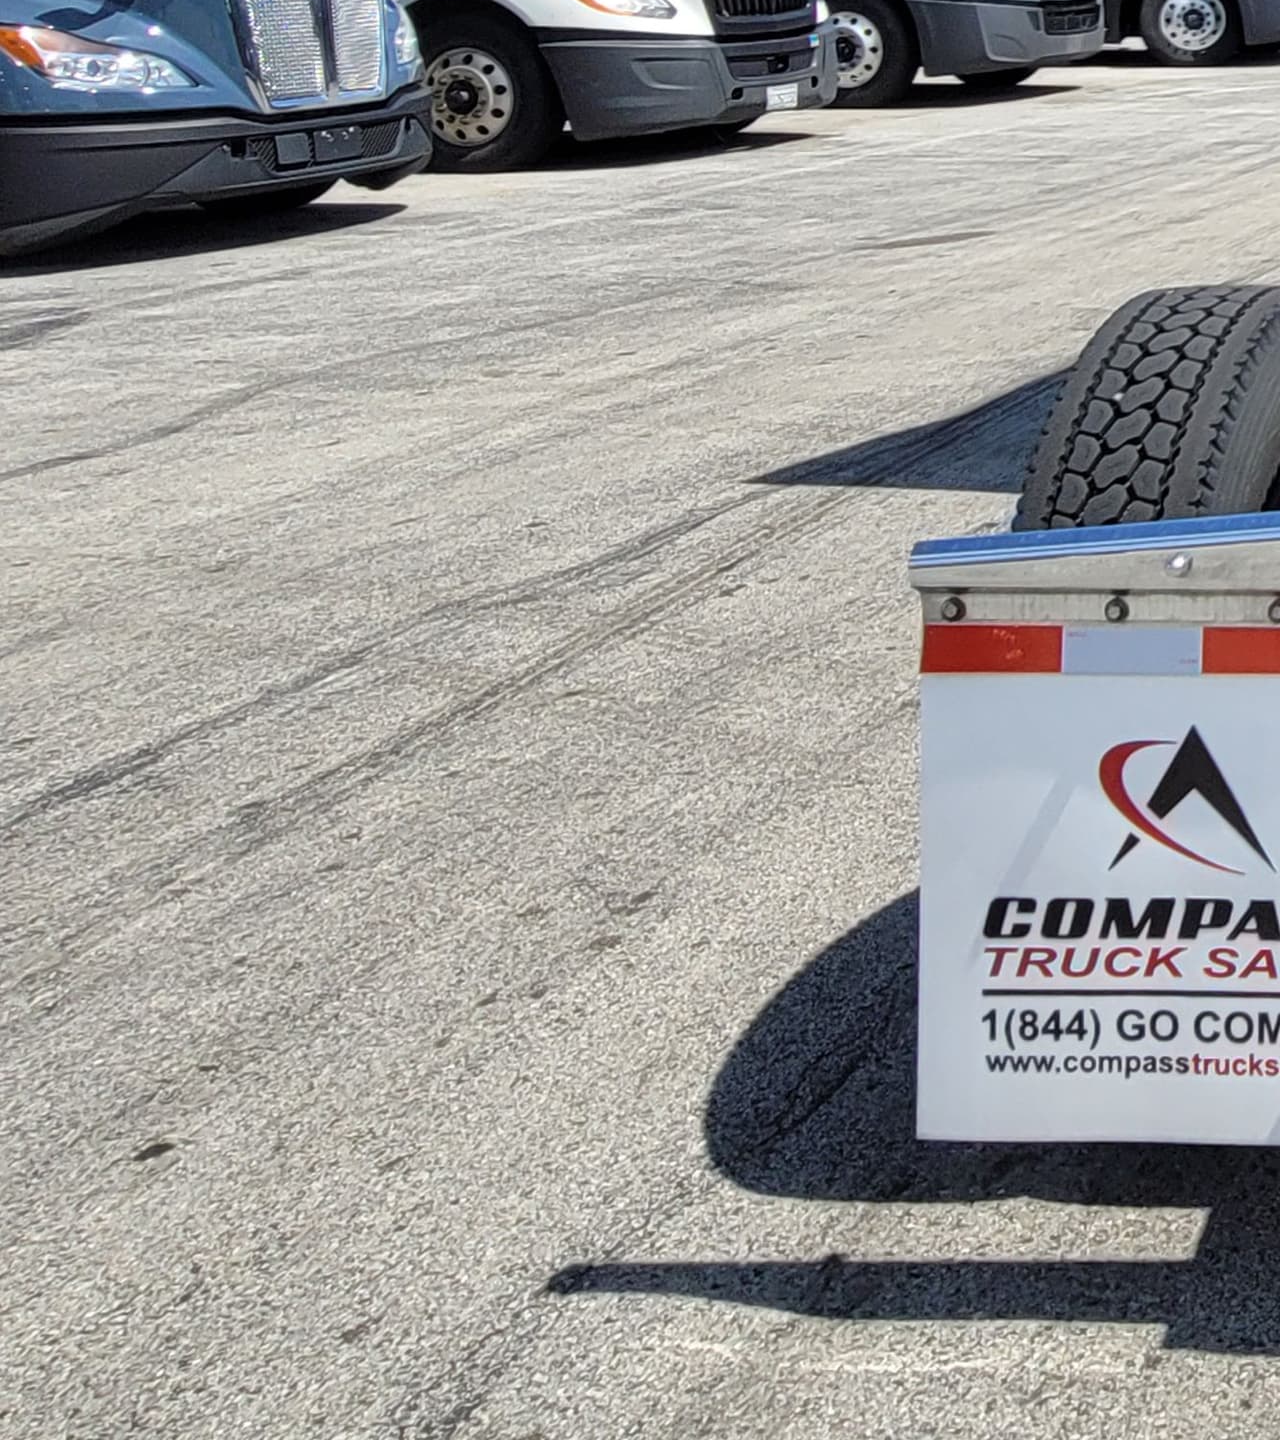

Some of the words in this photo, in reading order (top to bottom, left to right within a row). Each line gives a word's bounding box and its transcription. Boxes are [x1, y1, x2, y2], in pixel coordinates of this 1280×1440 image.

[984, 948, 1185, 978] TRUCK
[982, 1009, 1101, 1050] 1(844)
[1117, 1010, 1178, 1042] GO
